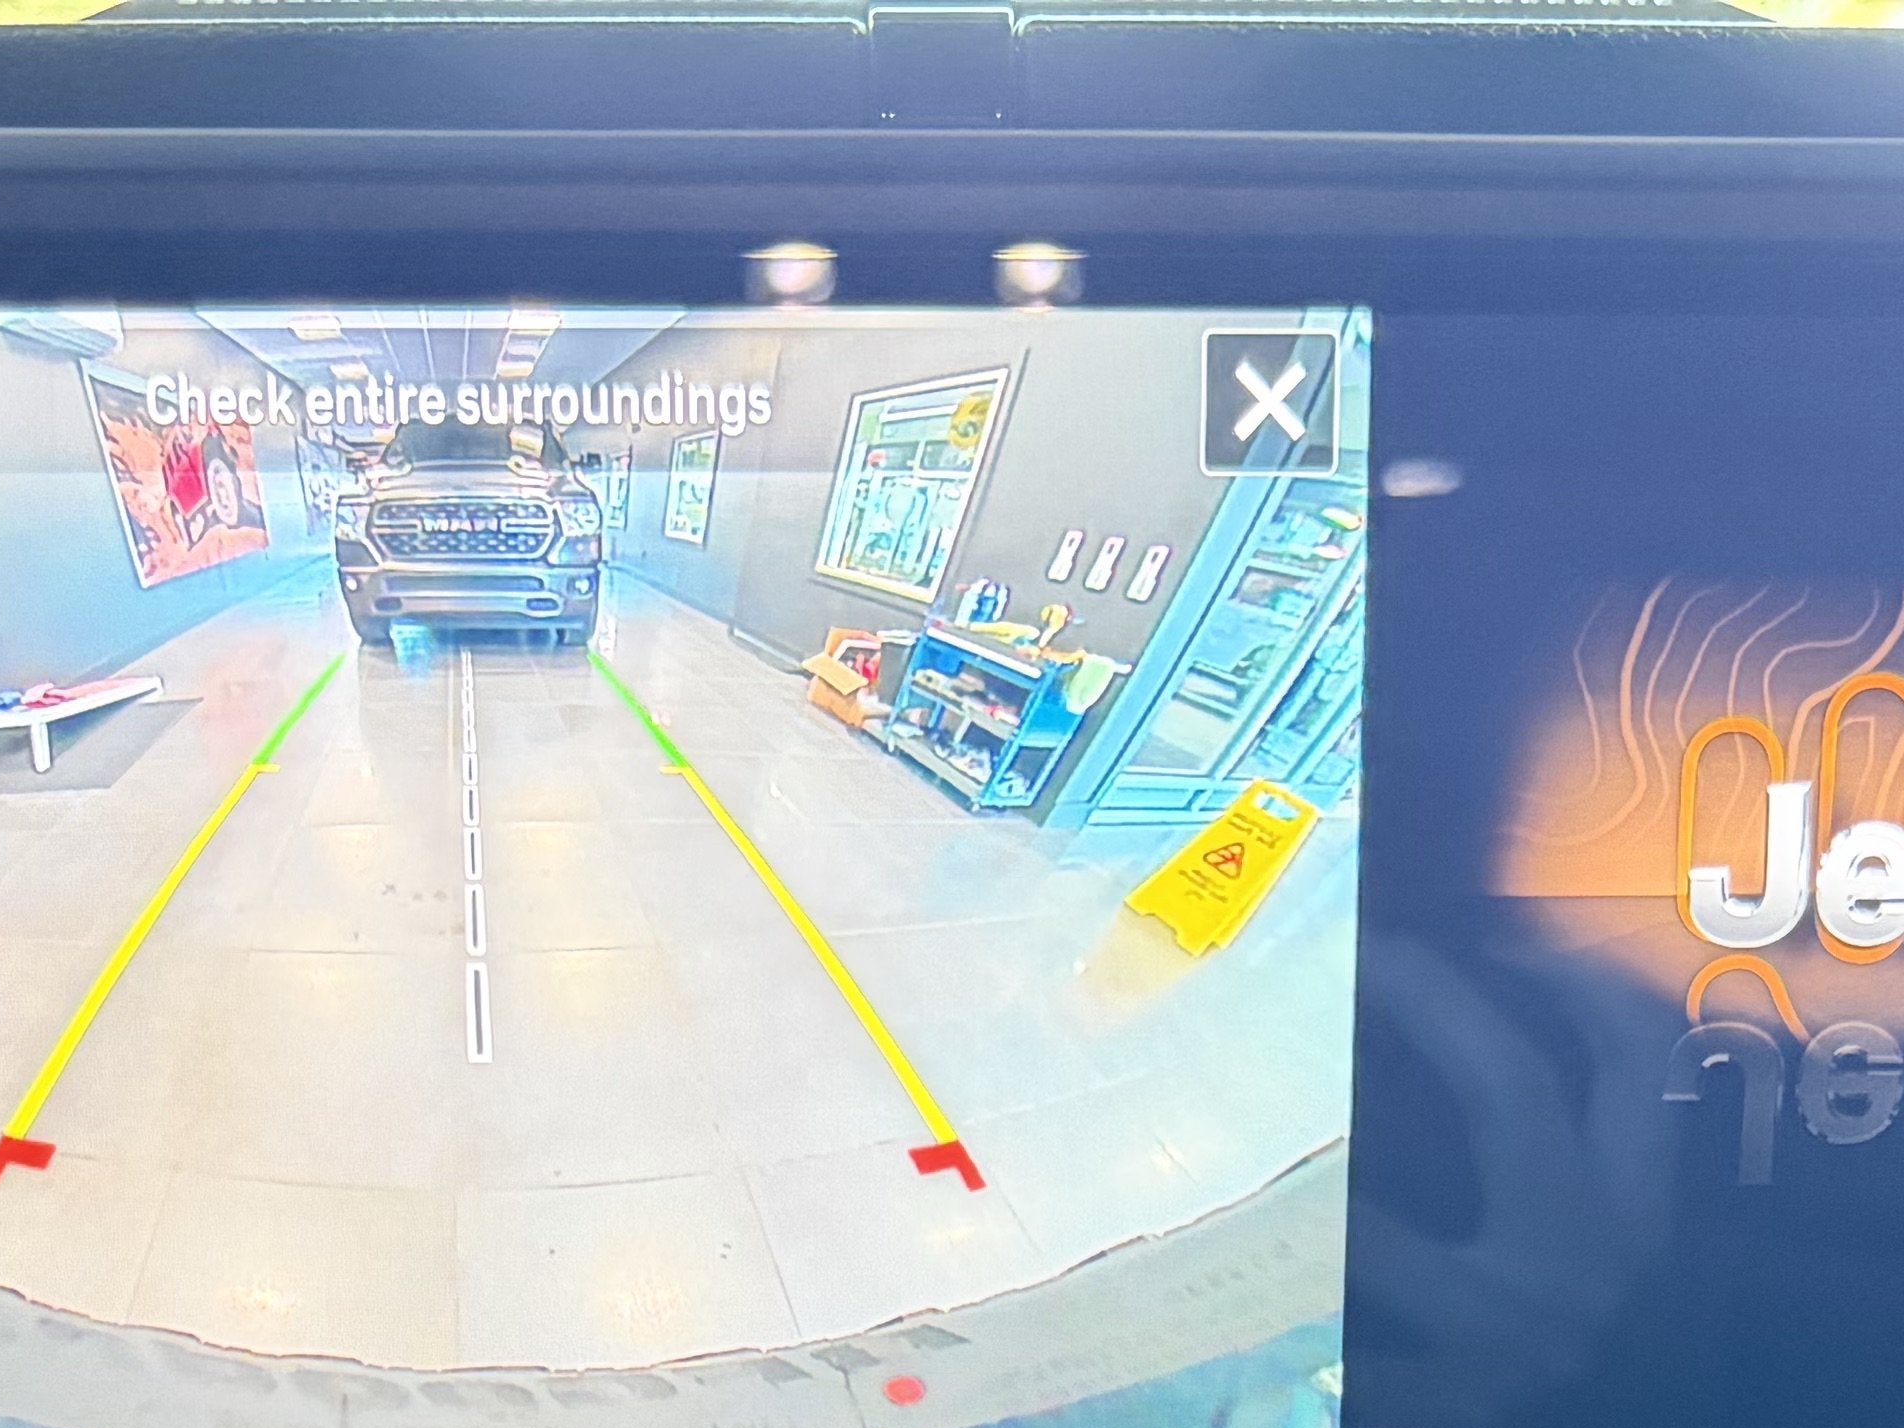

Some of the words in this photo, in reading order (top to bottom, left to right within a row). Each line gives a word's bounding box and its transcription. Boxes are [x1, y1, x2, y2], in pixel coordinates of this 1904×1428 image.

[145, 374, 296, 426] Check
[305, 376, 447, 426] entire
[455, 372, 772, 436] surroundings
